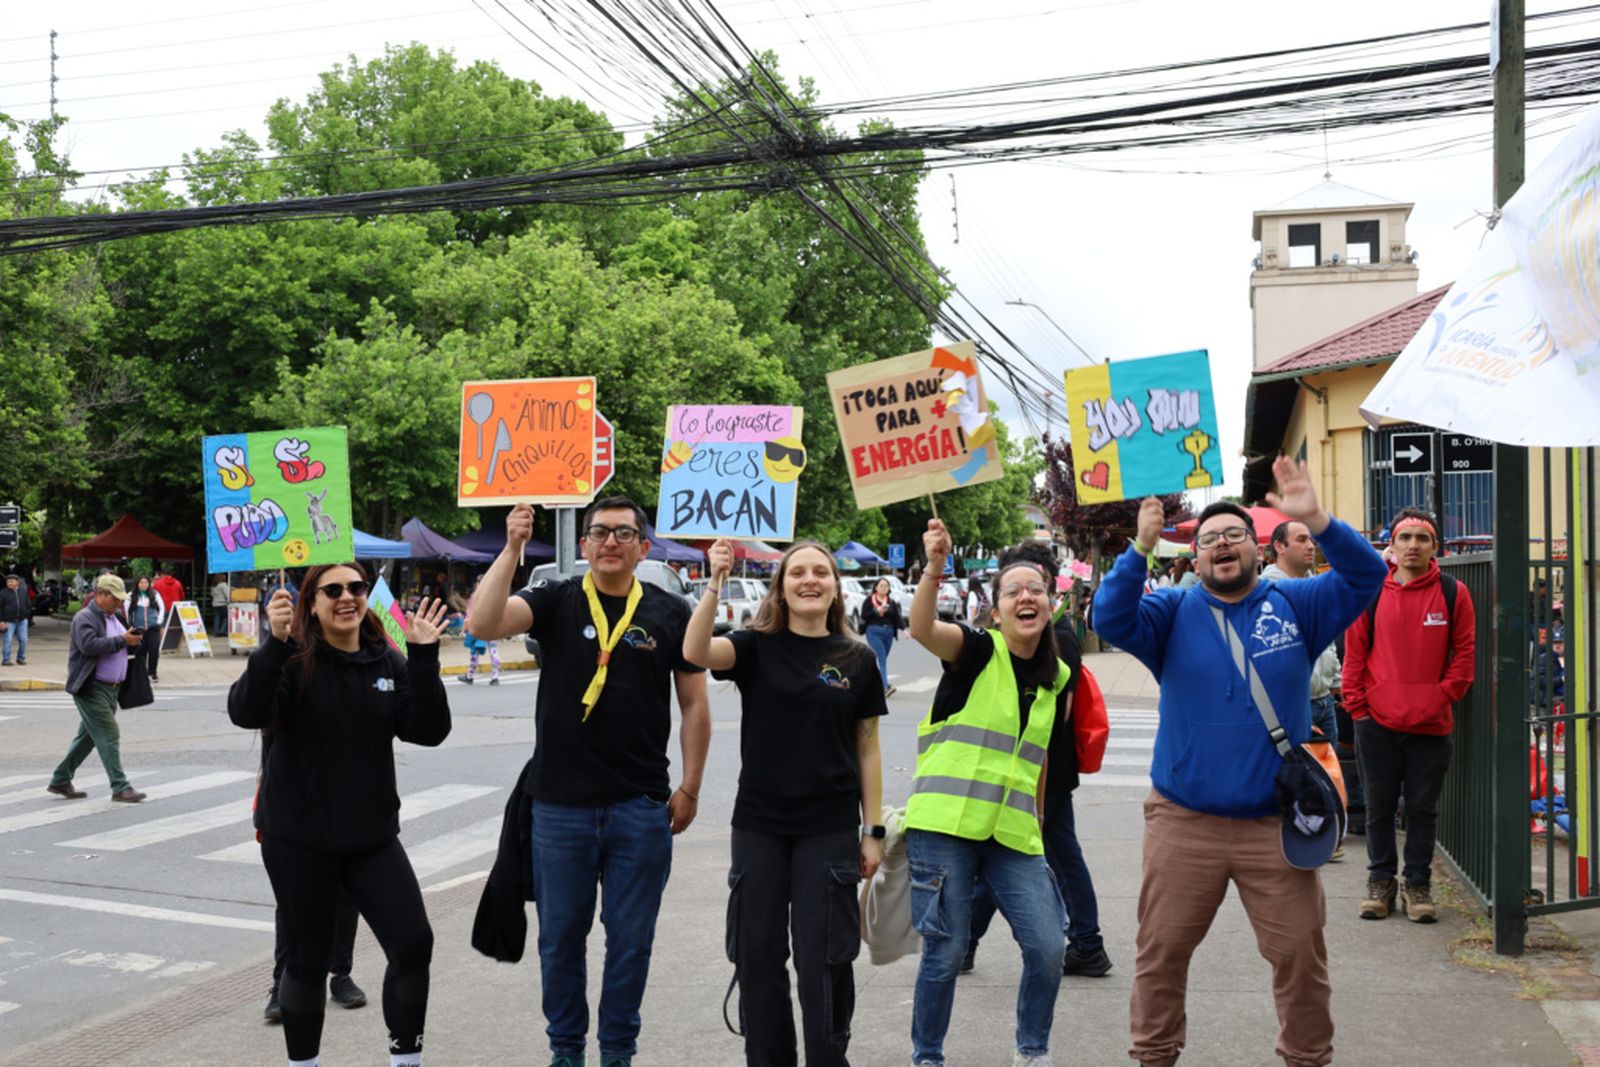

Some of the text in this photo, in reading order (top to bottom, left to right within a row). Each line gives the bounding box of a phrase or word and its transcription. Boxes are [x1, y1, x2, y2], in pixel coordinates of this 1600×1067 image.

[842, 368, 946, 415] ¡TOCA AQUÍ
[875, 407, 921, 433] PARA
[688, 447, 760, 479] eres
[213, 498, 289, 552] PUDO
[670, 479, 778, 536] BACÁN
